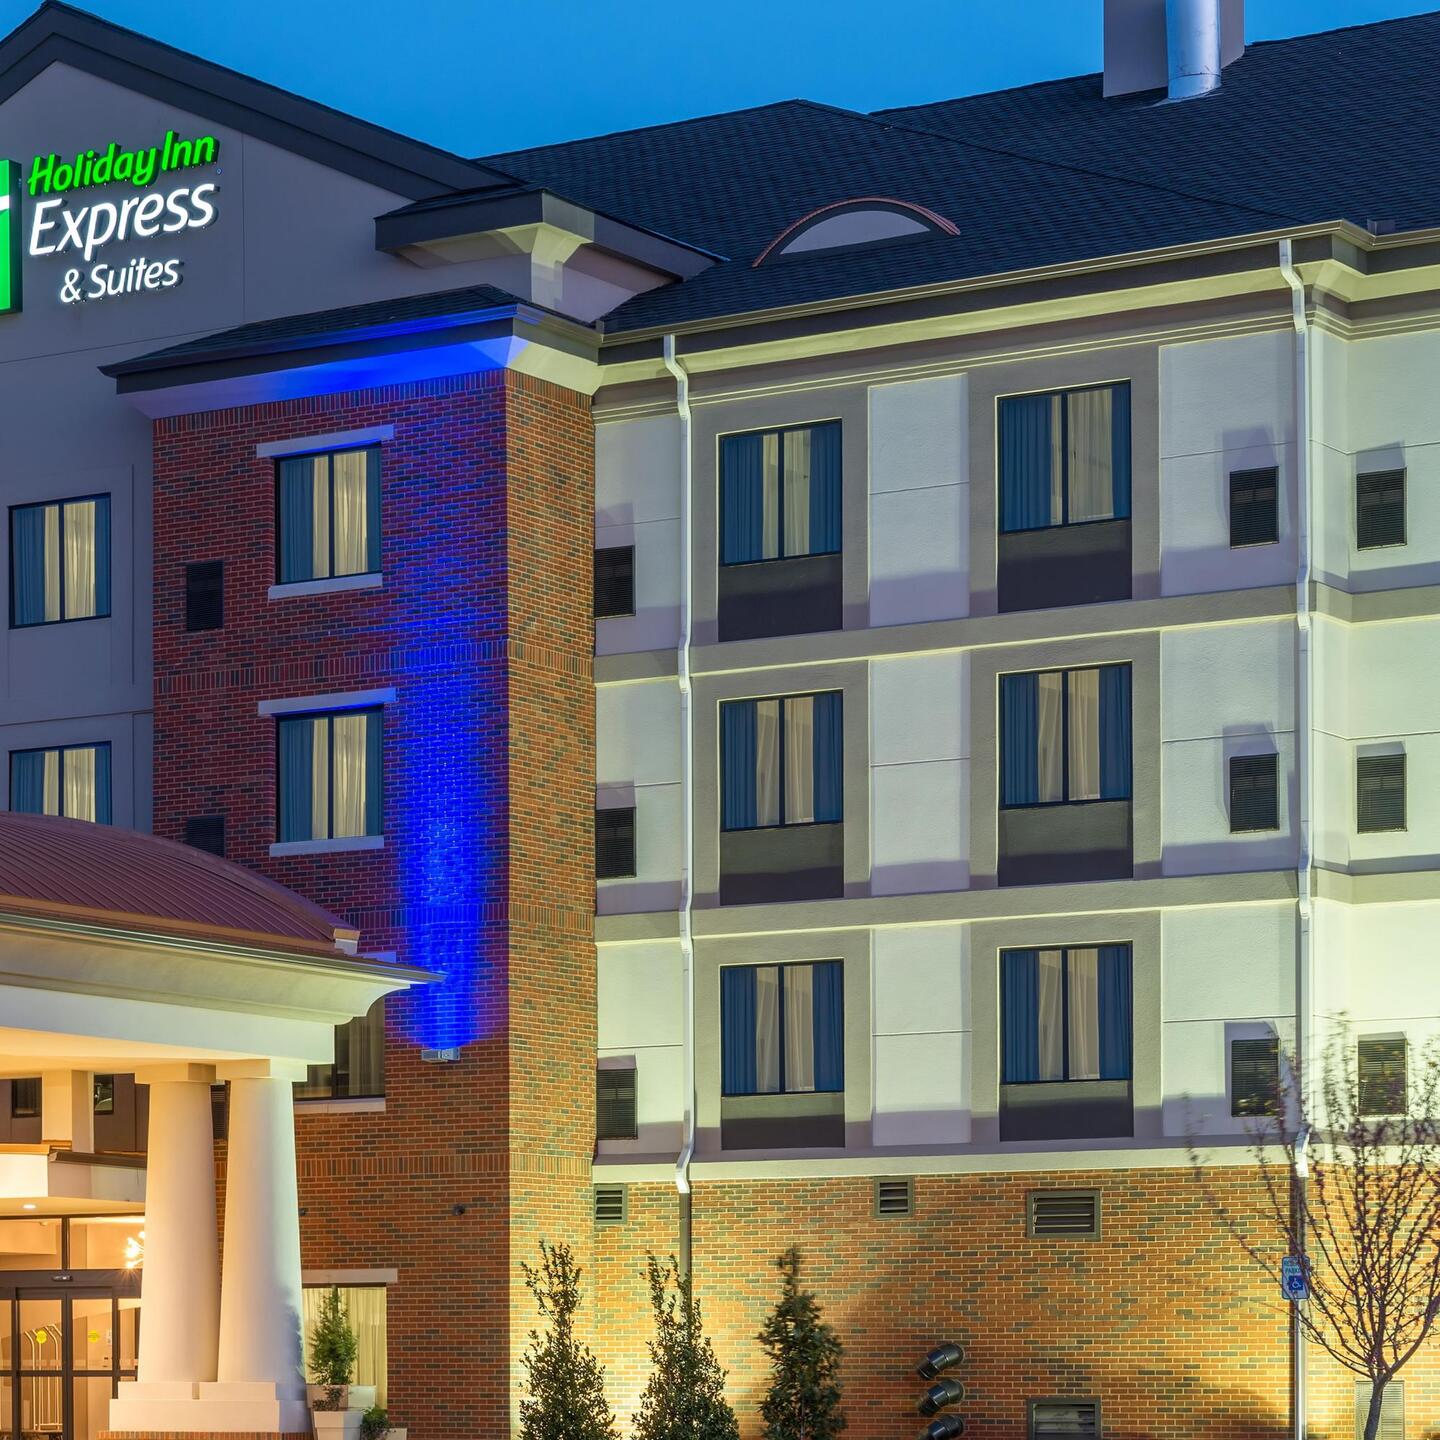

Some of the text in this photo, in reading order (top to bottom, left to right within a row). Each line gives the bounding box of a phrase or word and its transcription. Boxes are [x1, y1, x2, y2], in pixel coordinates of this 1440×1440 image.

[27, 130, 215, 196] Holiday Inn
[29, 183, 215, 261] Express
[60, 257, 180, 303] & Suites
